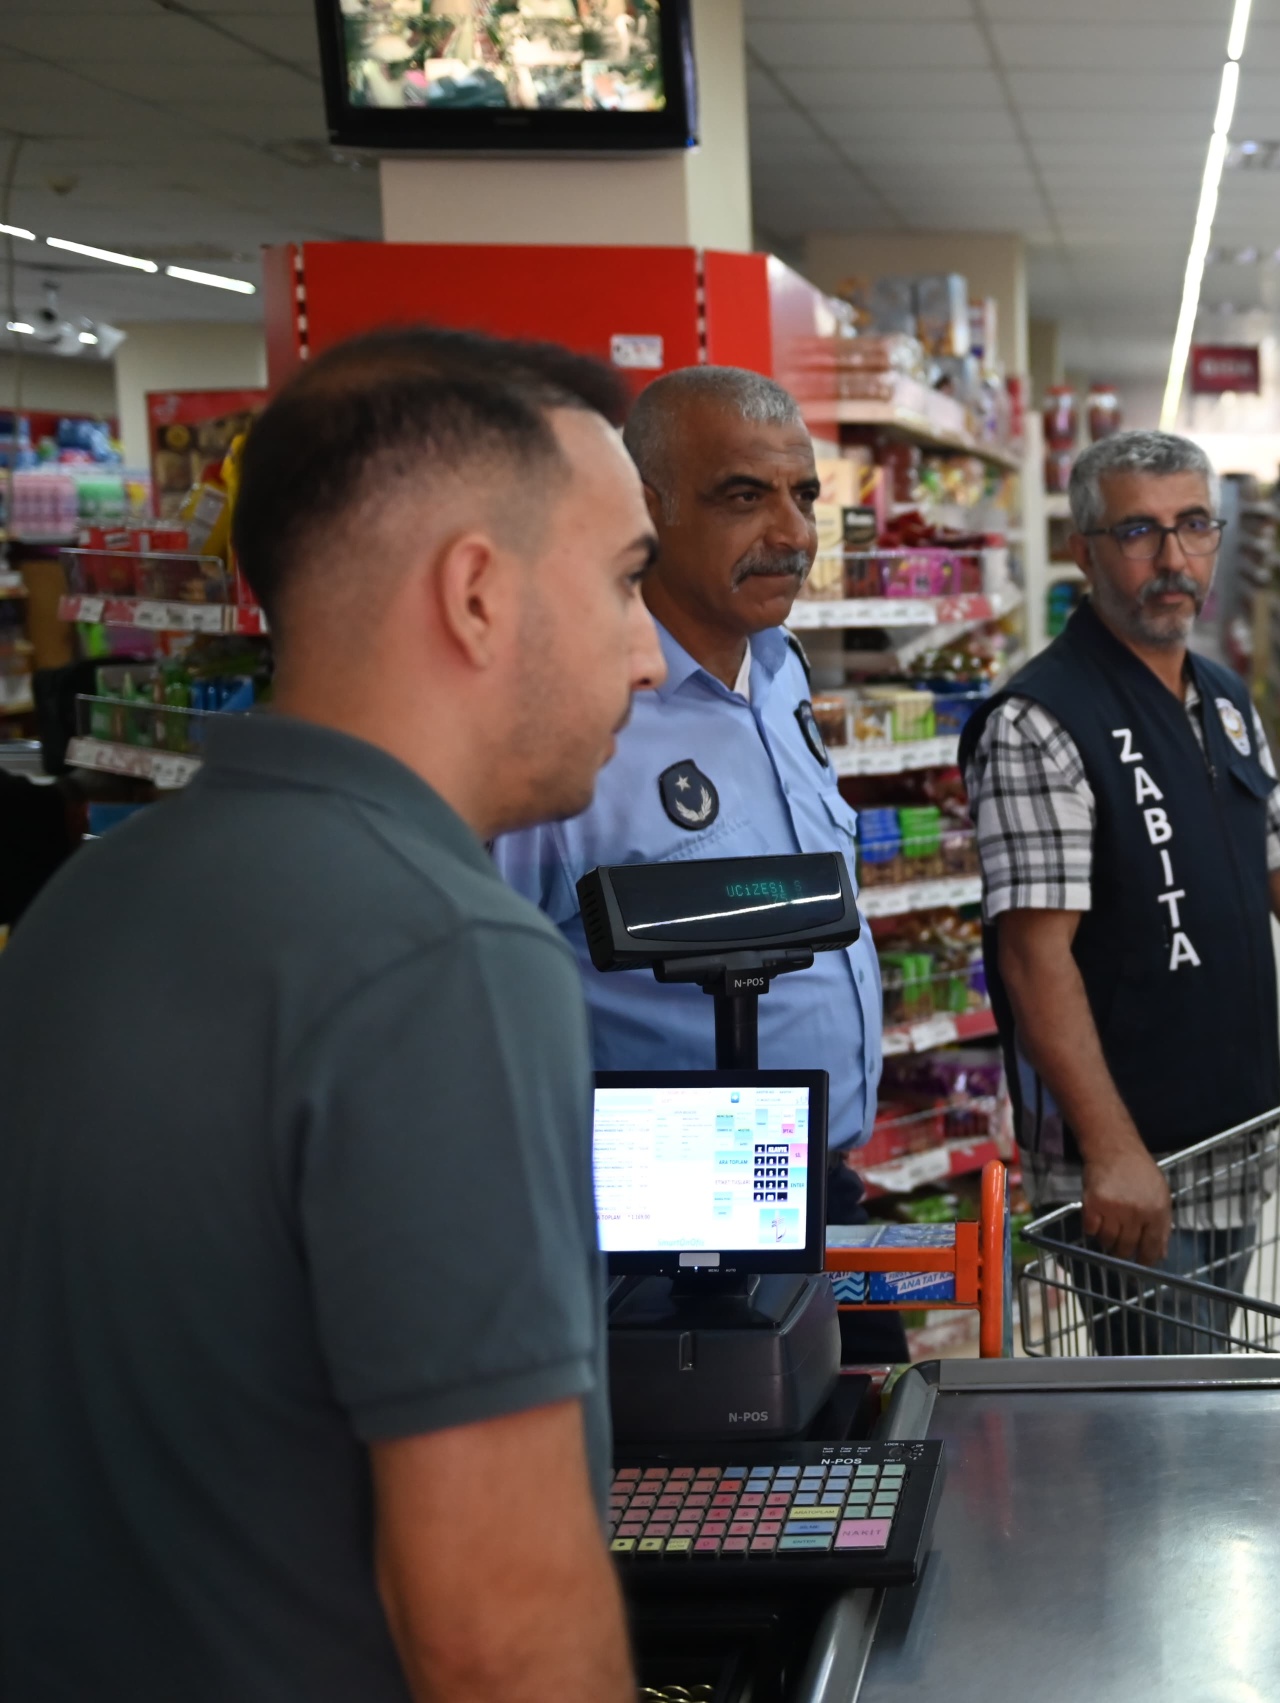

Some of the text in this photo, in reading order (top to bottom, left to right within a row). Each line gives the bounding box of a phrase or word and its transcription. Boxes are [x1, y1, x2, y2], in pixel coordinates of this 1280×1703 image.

[1112, 728, 1201, 971] ZABITA
[734, 977, 764, 988] N-POS
[728, 1411, 769, 1422] N-POS
